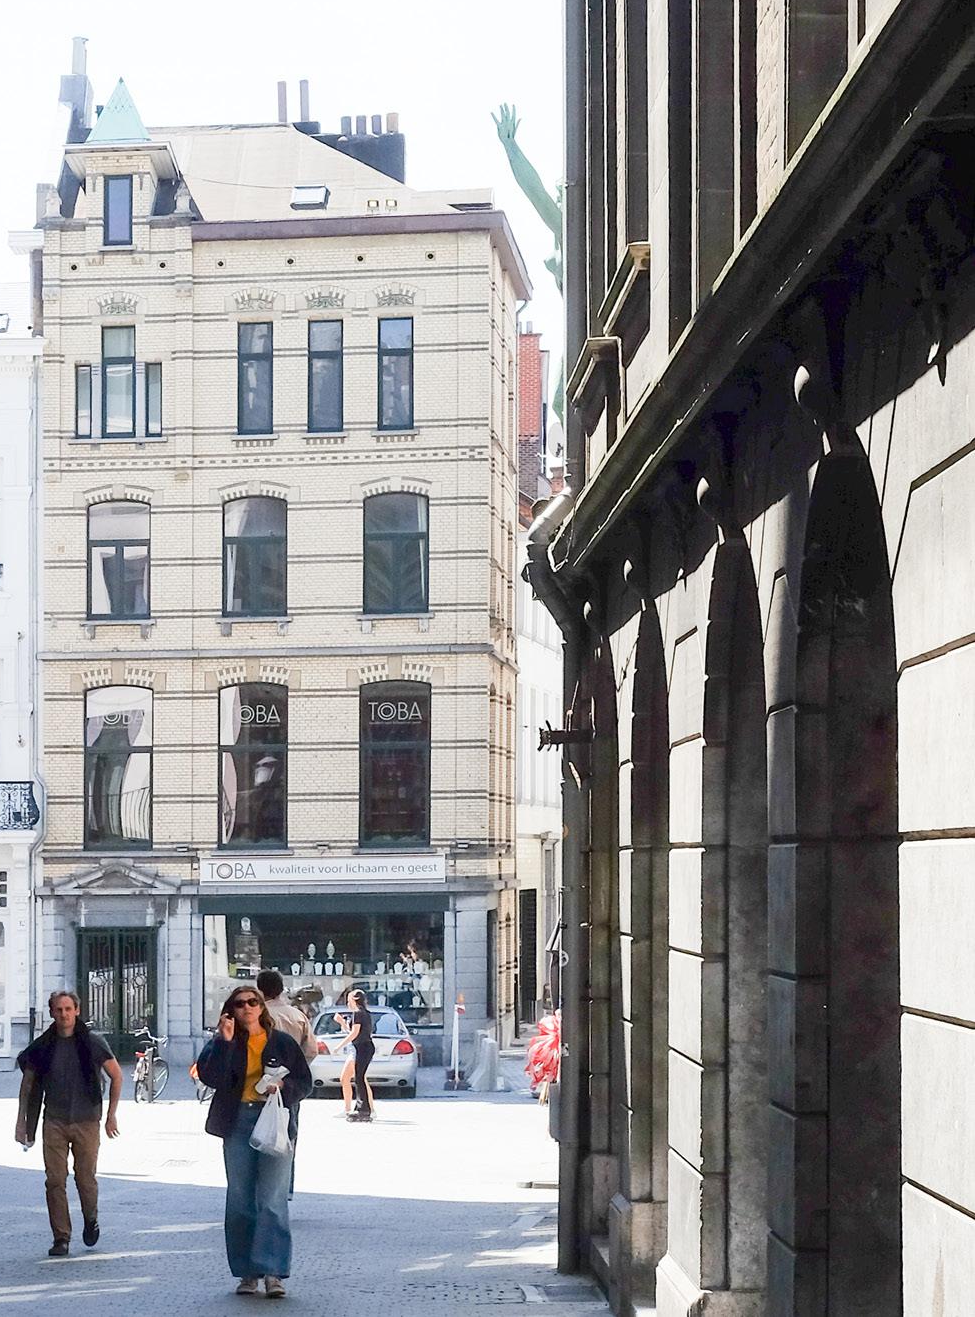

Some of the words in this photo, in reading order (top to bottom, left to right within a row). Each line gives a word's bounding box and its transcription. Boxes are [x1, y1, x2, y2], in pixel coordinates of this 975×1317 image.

[240, 704, 281, 724] OBA
[368, 702, 423, 721] TOBA
[208, 862, 256, 879] TOBA
[269, 864, 315, 874] kwaliteit
[318, 865, 342, 874] voor
[346, 863, 388, 873] lichaam
[391, 865, 405, 873] en
[407, 864, 438, 875] geest
